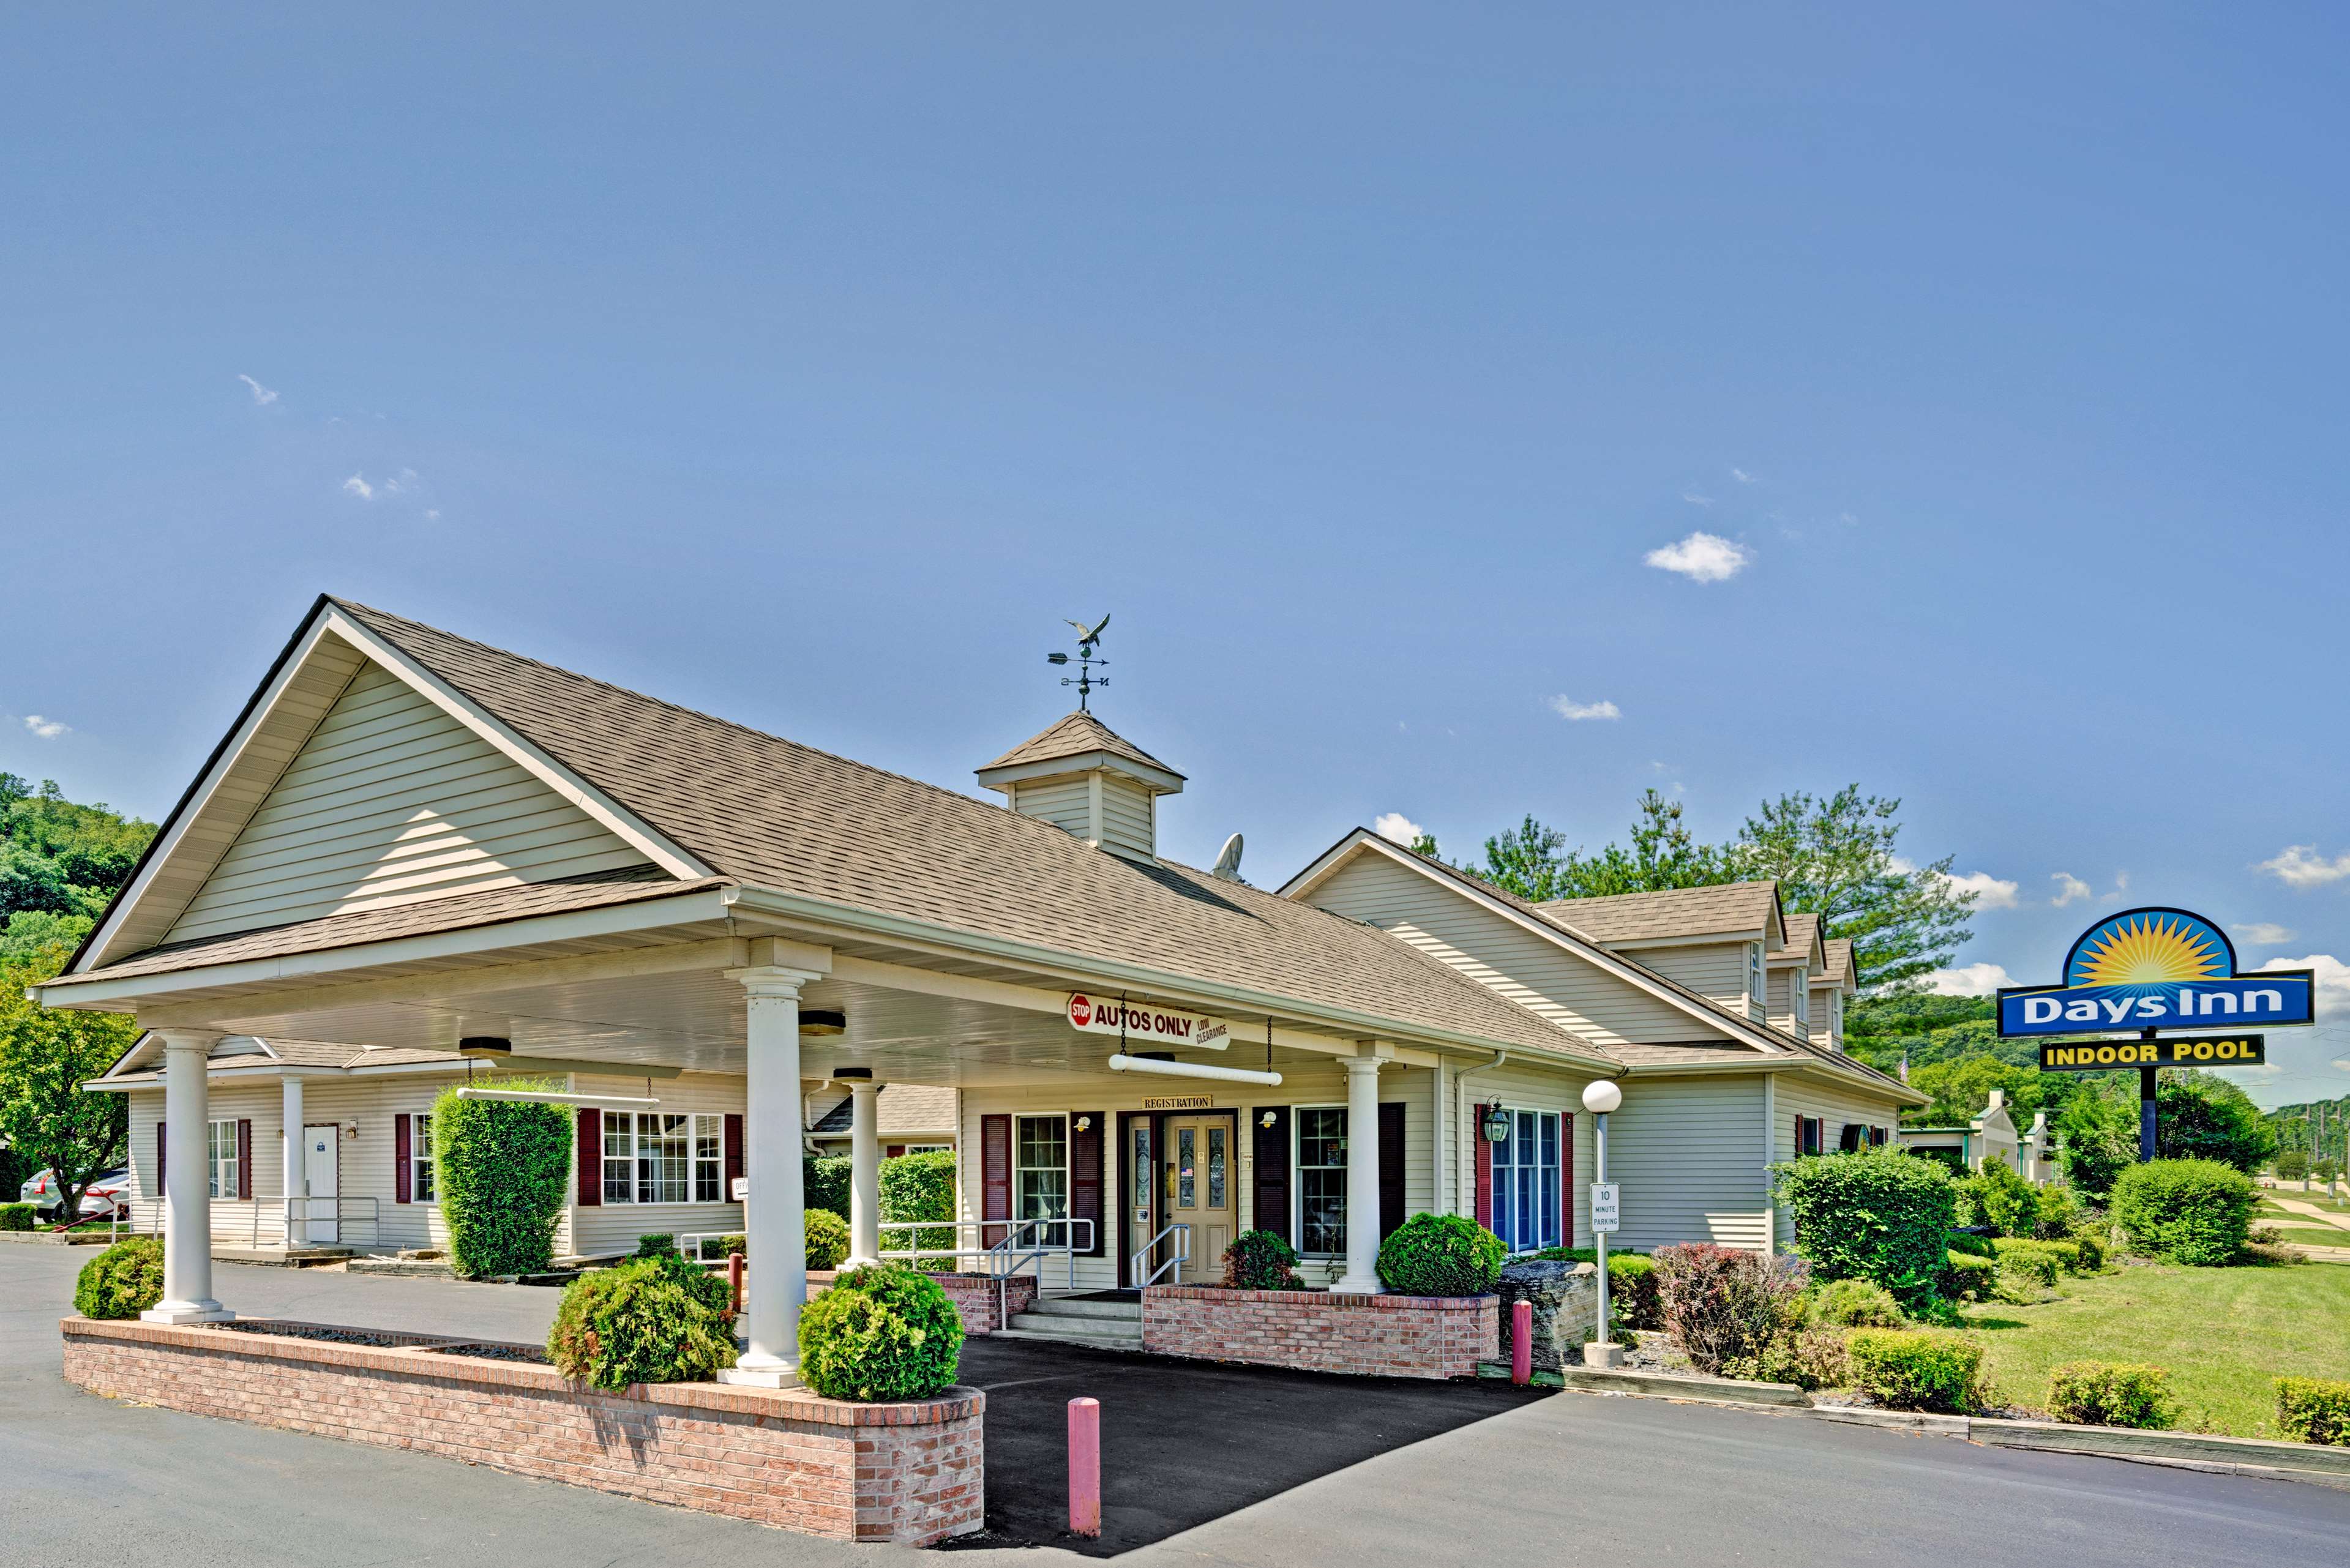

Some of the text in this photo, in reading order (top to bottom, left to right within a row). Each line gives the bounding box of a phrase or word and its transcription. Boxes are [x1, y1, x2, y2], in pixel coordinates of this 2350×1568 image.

[2024, 989, 2282, 1023] Days Inn
[1072, 1003, 1192, 1037] STOP AUTOS ONLY
[1197, 1018, 1209, 1031] LOW
[1196, 1024, 1227, 1044] CLEARANCE
[2046, 1041, 2256, 1066] INDOOR POOL
[1145, 1097, 1208, 1108] REGISTRATION
[1601, 1191, 1610, 1200] 10
